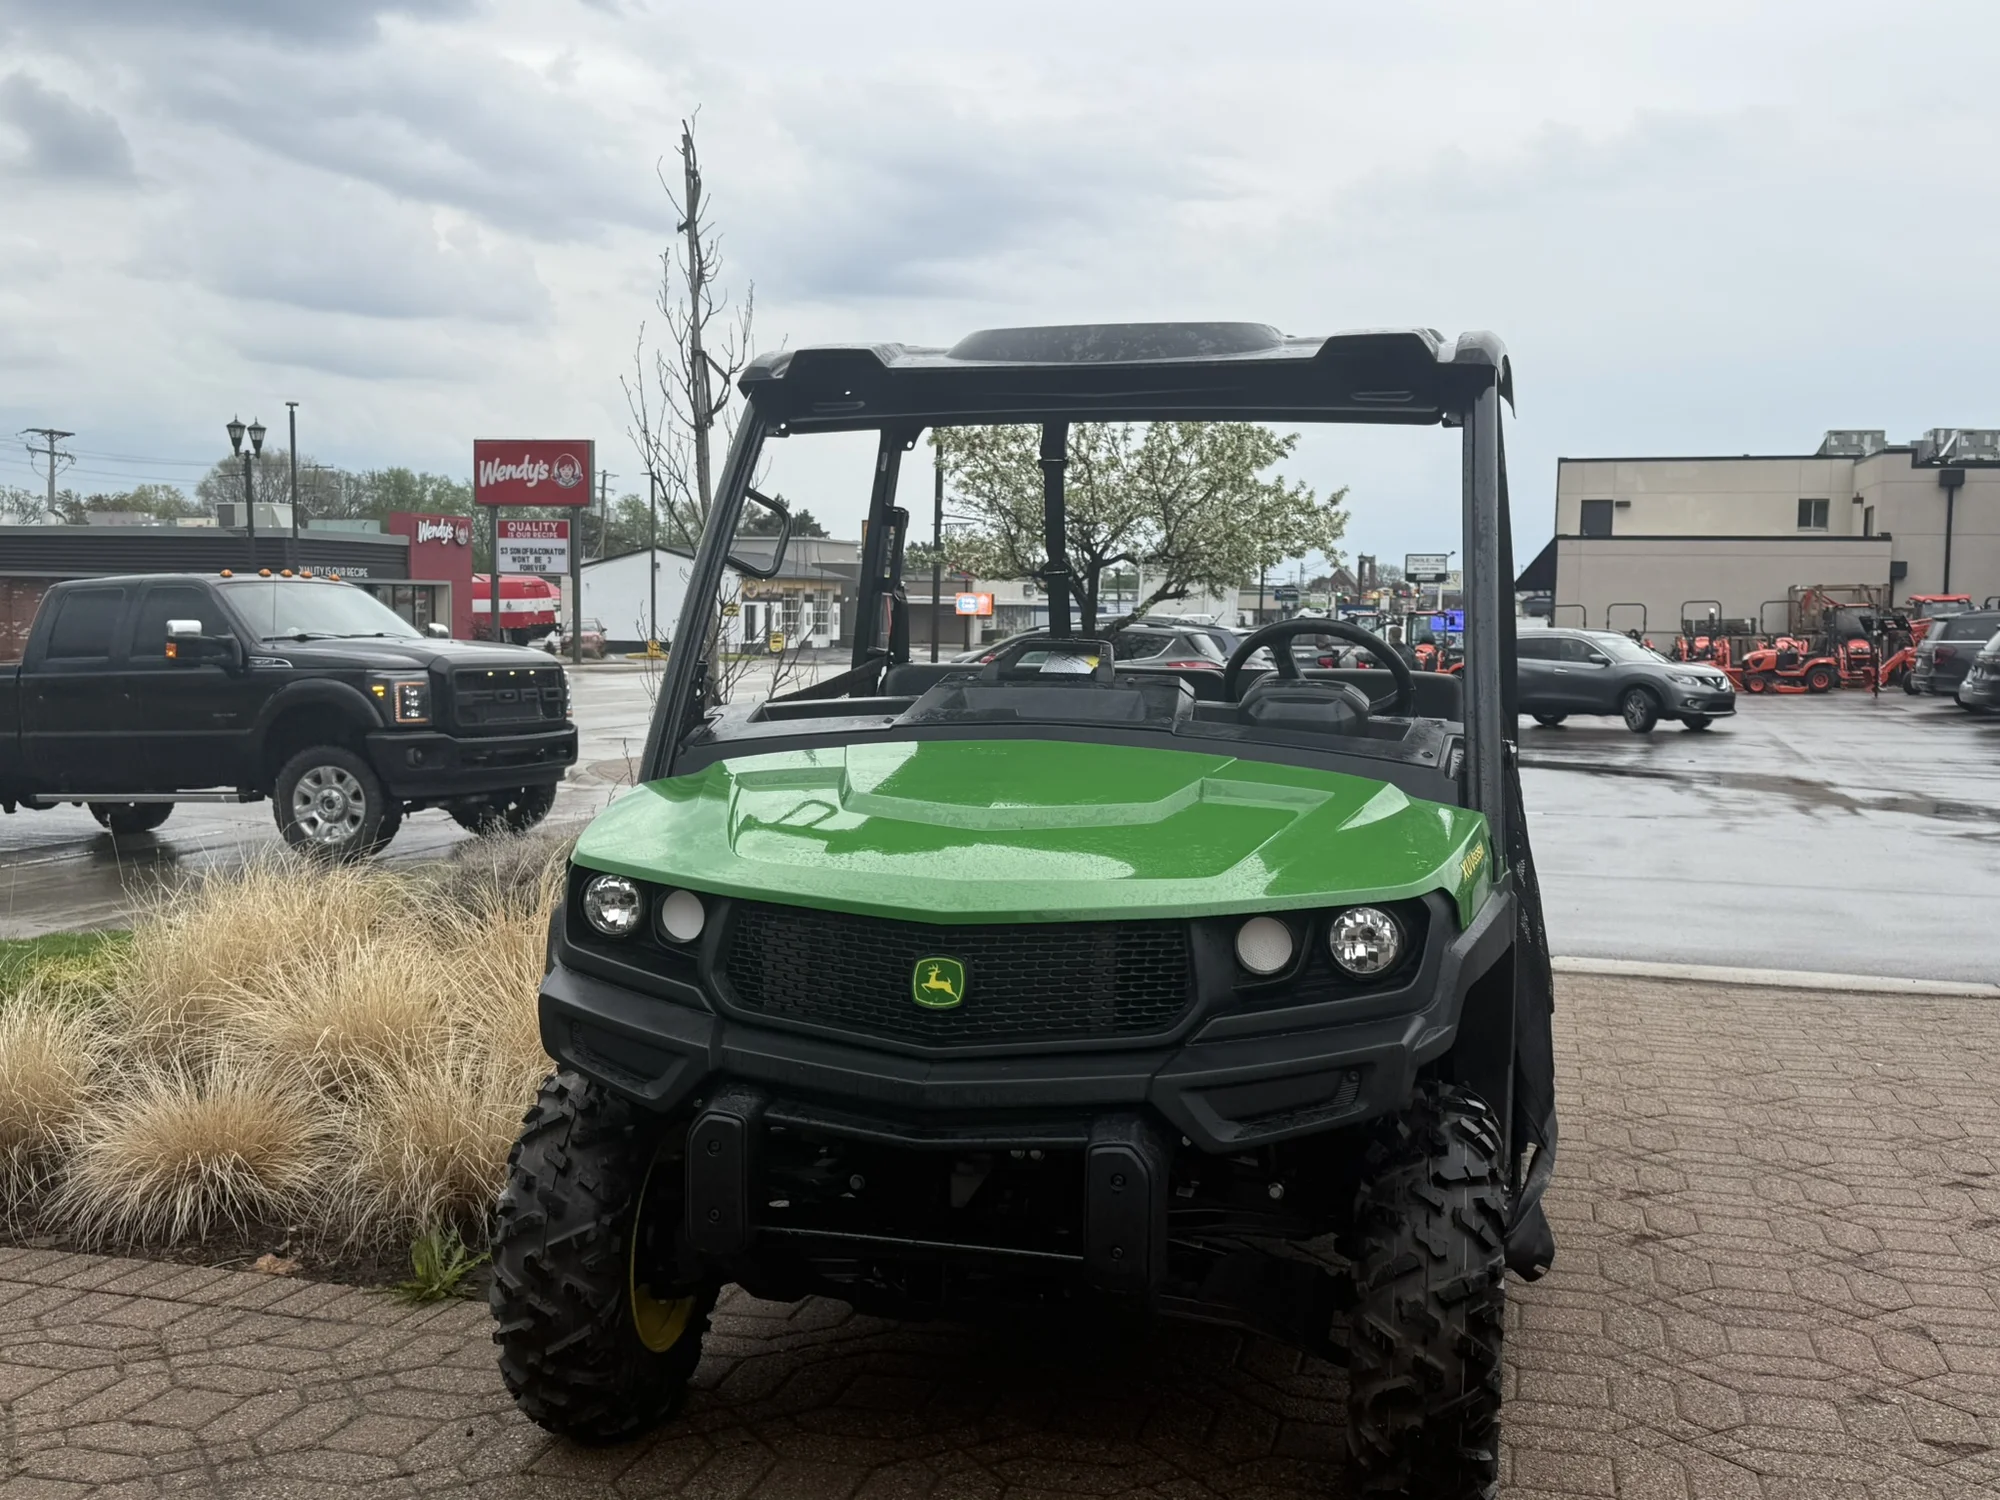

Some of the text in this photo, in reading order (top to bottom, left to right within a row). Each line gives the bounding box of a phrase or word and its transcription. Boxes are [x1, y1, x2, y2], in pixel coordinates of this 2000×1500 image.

[479, 454, 550, 488] Wendy's
[417, 518, 454, 545] Wendy's
[507, 522, 559, 532] QUALITY
[346, 567, 368, 578] RECIPE
[519, 563, 547, 572] FOREVER
